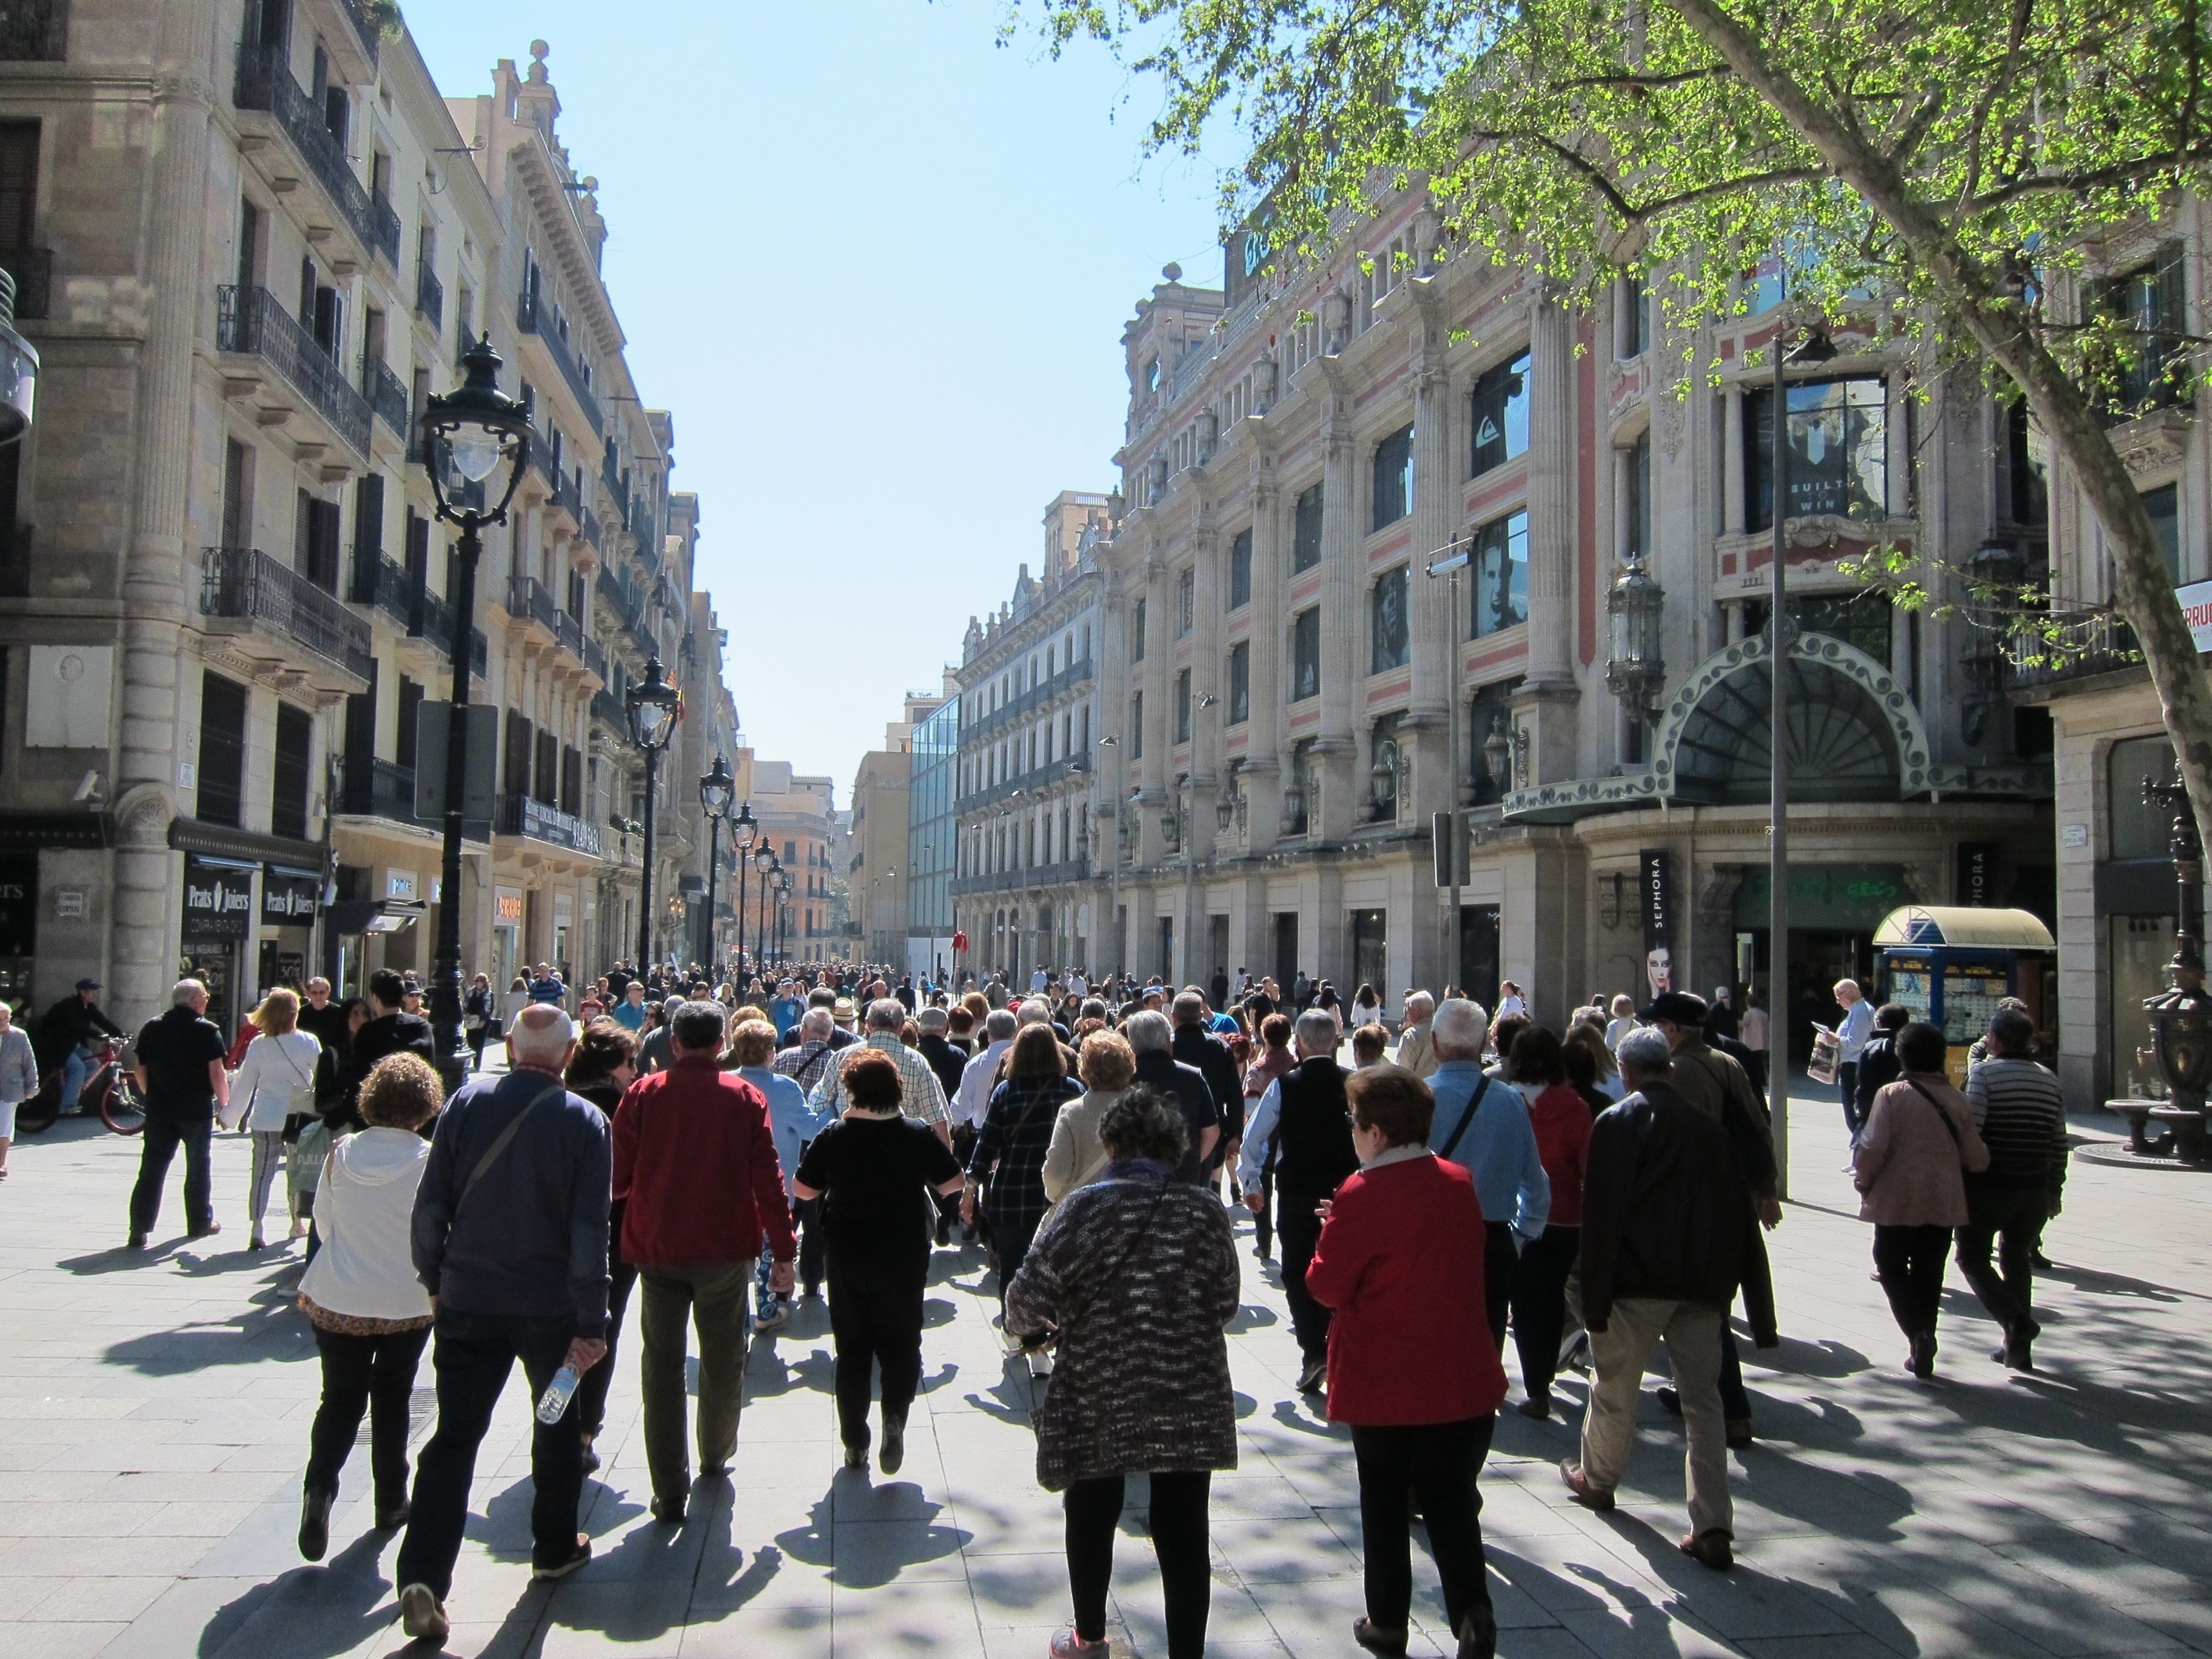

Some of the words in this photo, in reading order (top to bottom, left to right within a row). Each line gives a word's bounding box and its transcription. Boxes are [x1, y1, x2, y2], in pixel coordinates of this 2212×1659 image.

[1791, 480, 1843, 493] BUILT
[1808, 491, 1828, 500] TO
[1800, 500, 1834, 511] WIN
[2184, 603, 2212, 628] RRU
[0, 884, 23, 899] rs
[189, 885, 212, 908] Prats
[222, 888, 249, 913] Joiers
[1652, 859, 1663, 928] SEPHORA
[266, 891, 286, 912] Prats
[293, 894, 313, 916] Joiers
